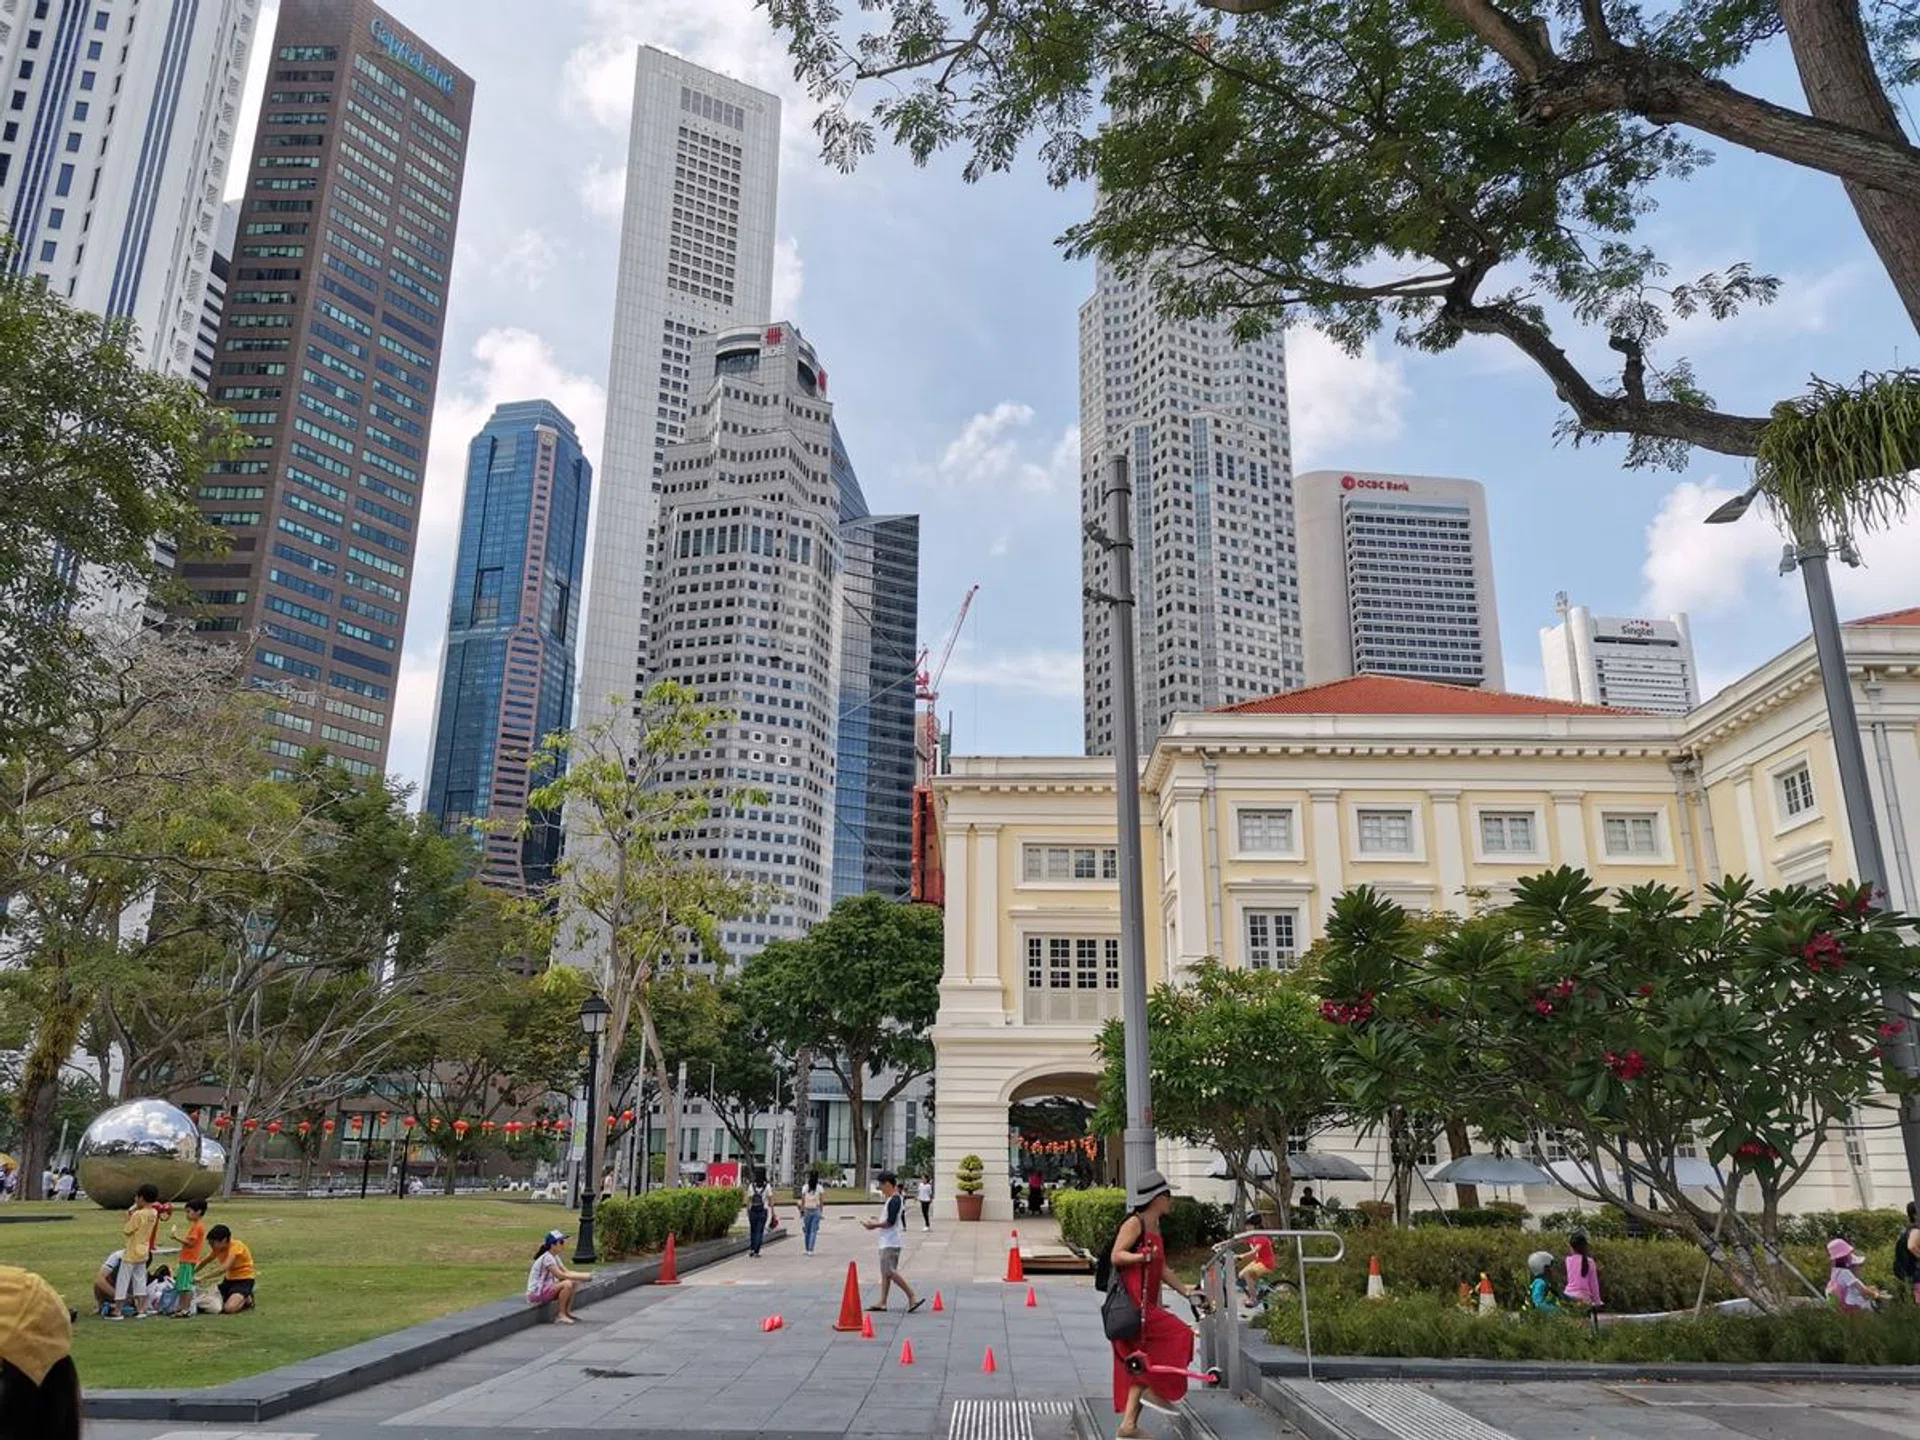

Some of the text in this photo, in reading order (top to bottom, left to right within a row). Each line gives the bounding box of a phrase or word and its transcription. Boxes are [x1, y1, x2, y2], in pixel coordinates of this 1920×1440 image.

[760, 345, 786, 358] UOB
[1357, 479, 1409, 492] OCBC Bank
[1622, 625, 1654, 637] Singtel
